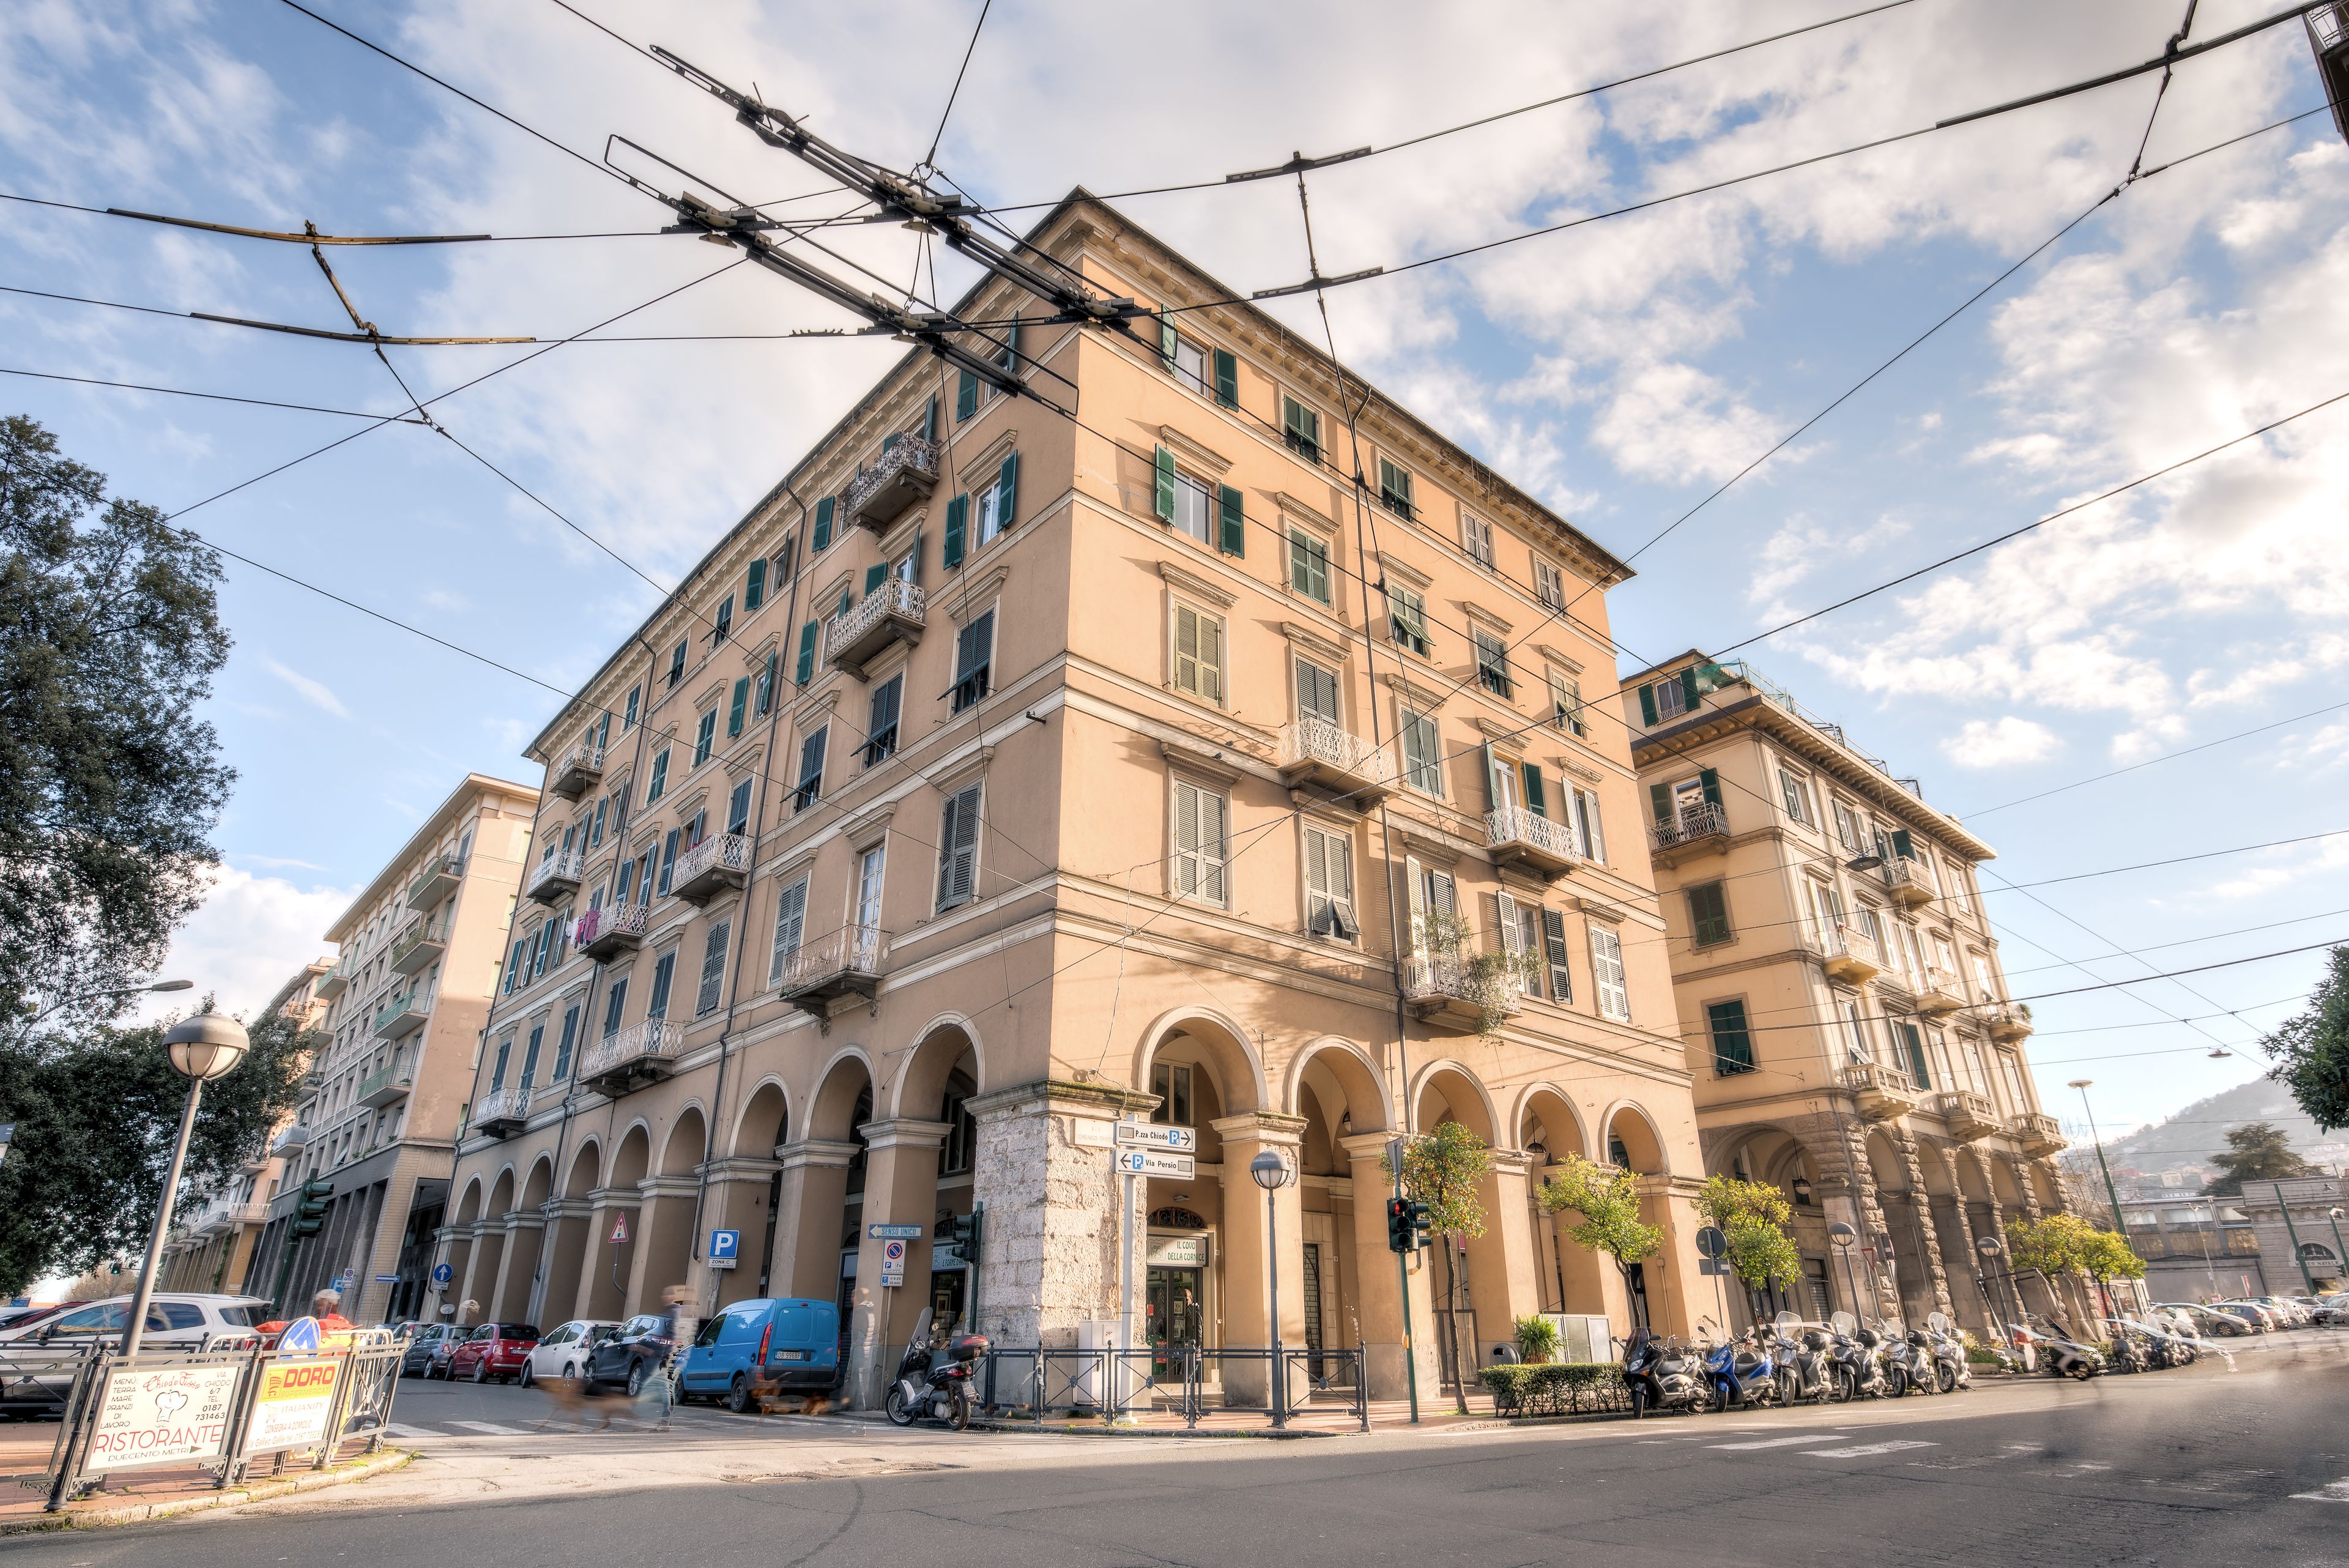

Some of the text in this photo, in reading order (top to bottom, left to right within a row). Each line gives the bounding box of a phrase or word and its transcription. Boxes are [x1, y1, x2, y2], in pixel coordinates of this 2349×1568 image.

[1135, 1130, 1148, 1139] P.zza
[1150, 1132, 1168, 1140] Chiodo
[714, 1233, 733, 1255] P
[1177, 1241, 1181, 1249] IL
[1168, 1252, 1204, 1261] DELLA CORNICE
[114, 1377, 139, 1385] MENÙ:
[143, 1373, 179, 1392] Chiodo
[283, 1366, 335, 1388] DORO
[280, 1386, 332, 1398] SUPERMERCATI
[281, 1402, 324, 1413] ITALIANITY
[195, 1412, 225, 1421] 731463
[100, 1421, 130, 1429] LAVORO
[265, 1423, 287, 1433] CONSEGNA
[292, 1419, 312, 1430] DOMICILIO
[93, 1424, 225, 1454] RISTORANTE
[108, 1451, 160, 1462] DUECENTO
